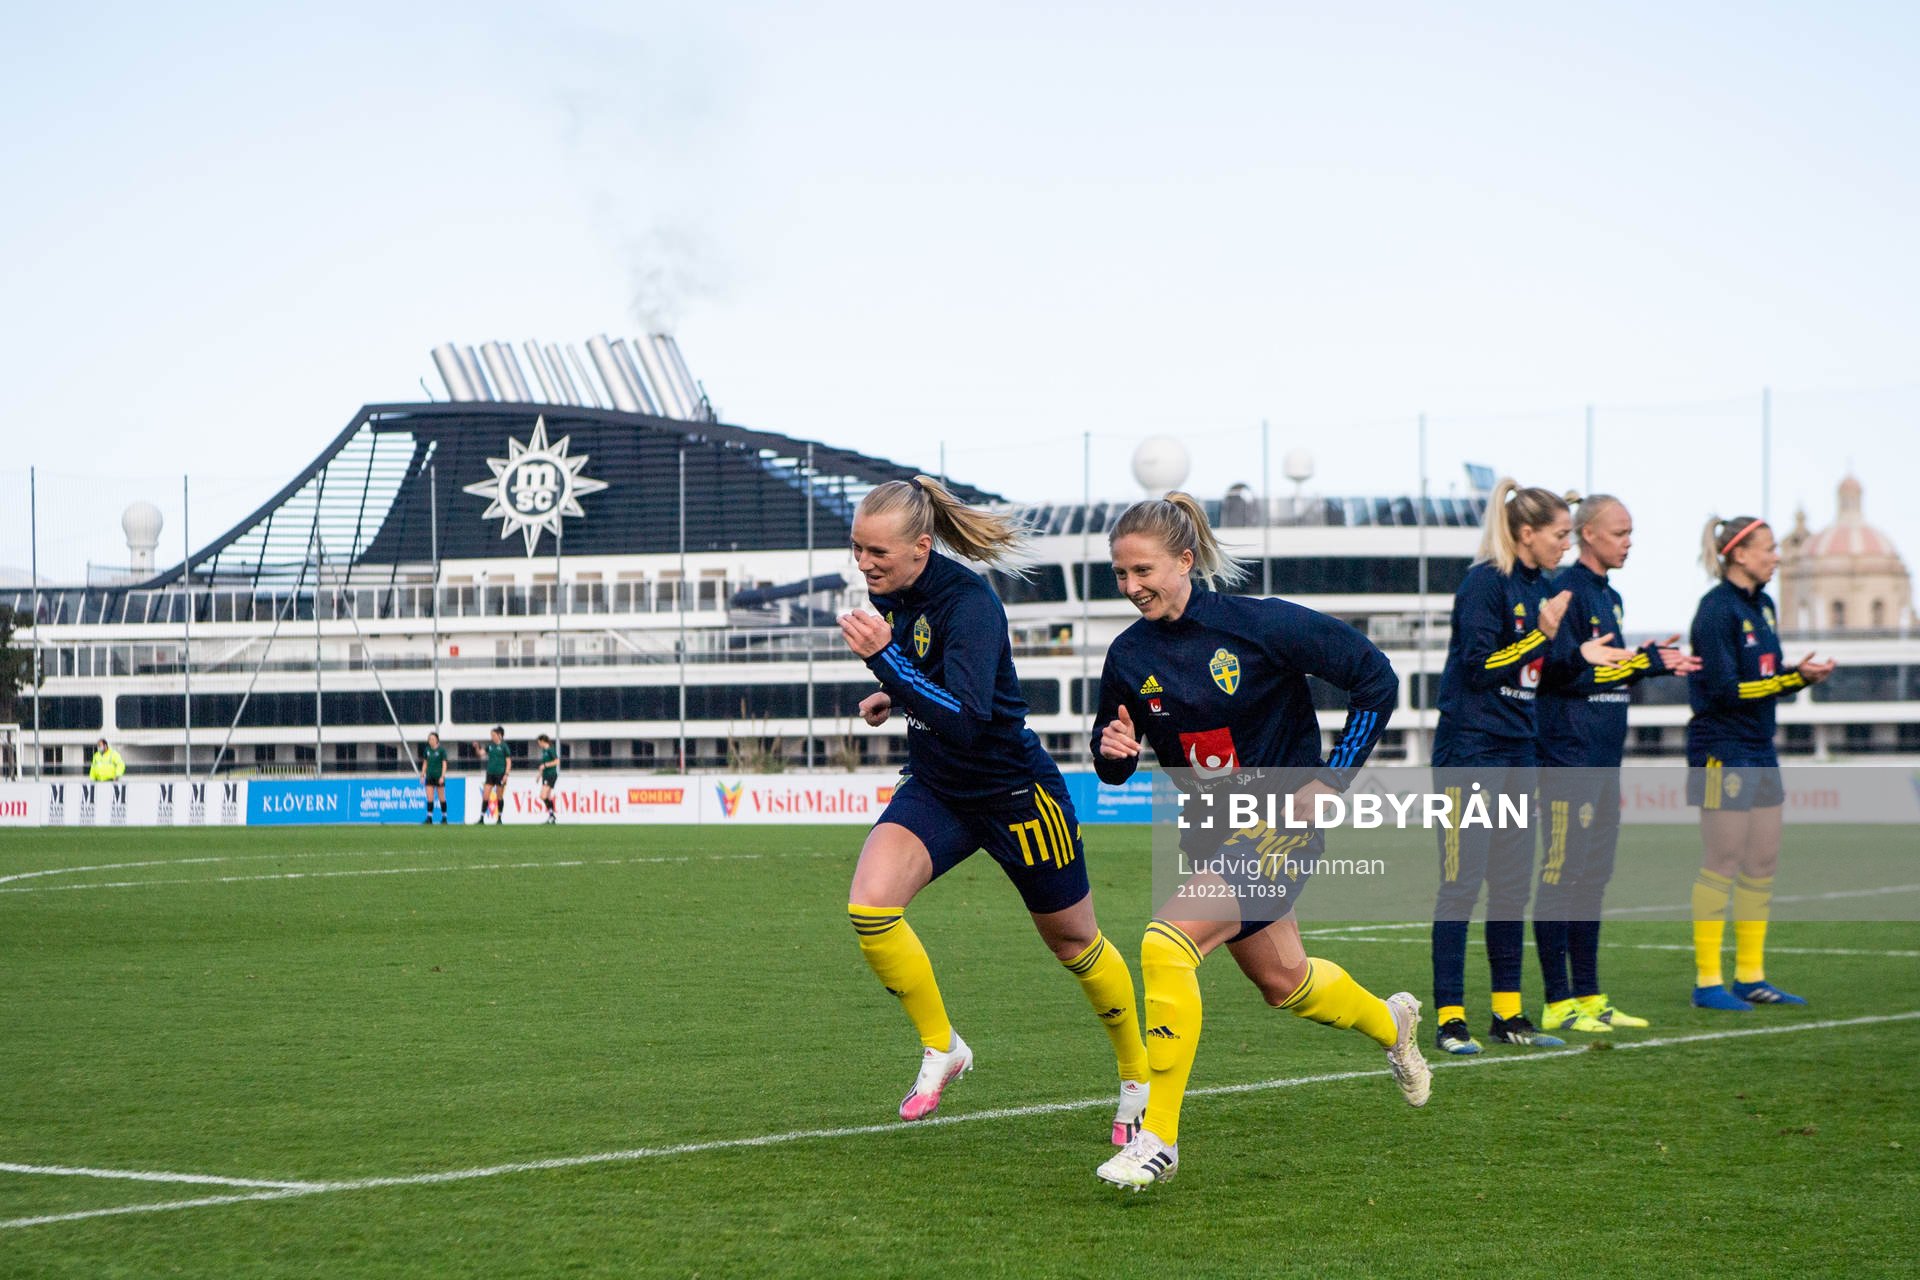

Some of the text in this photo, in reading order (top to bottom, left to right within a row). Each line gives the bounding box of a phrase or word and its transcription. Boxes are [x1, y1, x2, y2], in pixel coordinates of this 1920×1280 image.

[263, 793, 338, 812] KLÖVERN
[752, 789, 868, 813] VisitMalta
[1009, 819, 1049, 866] 11
